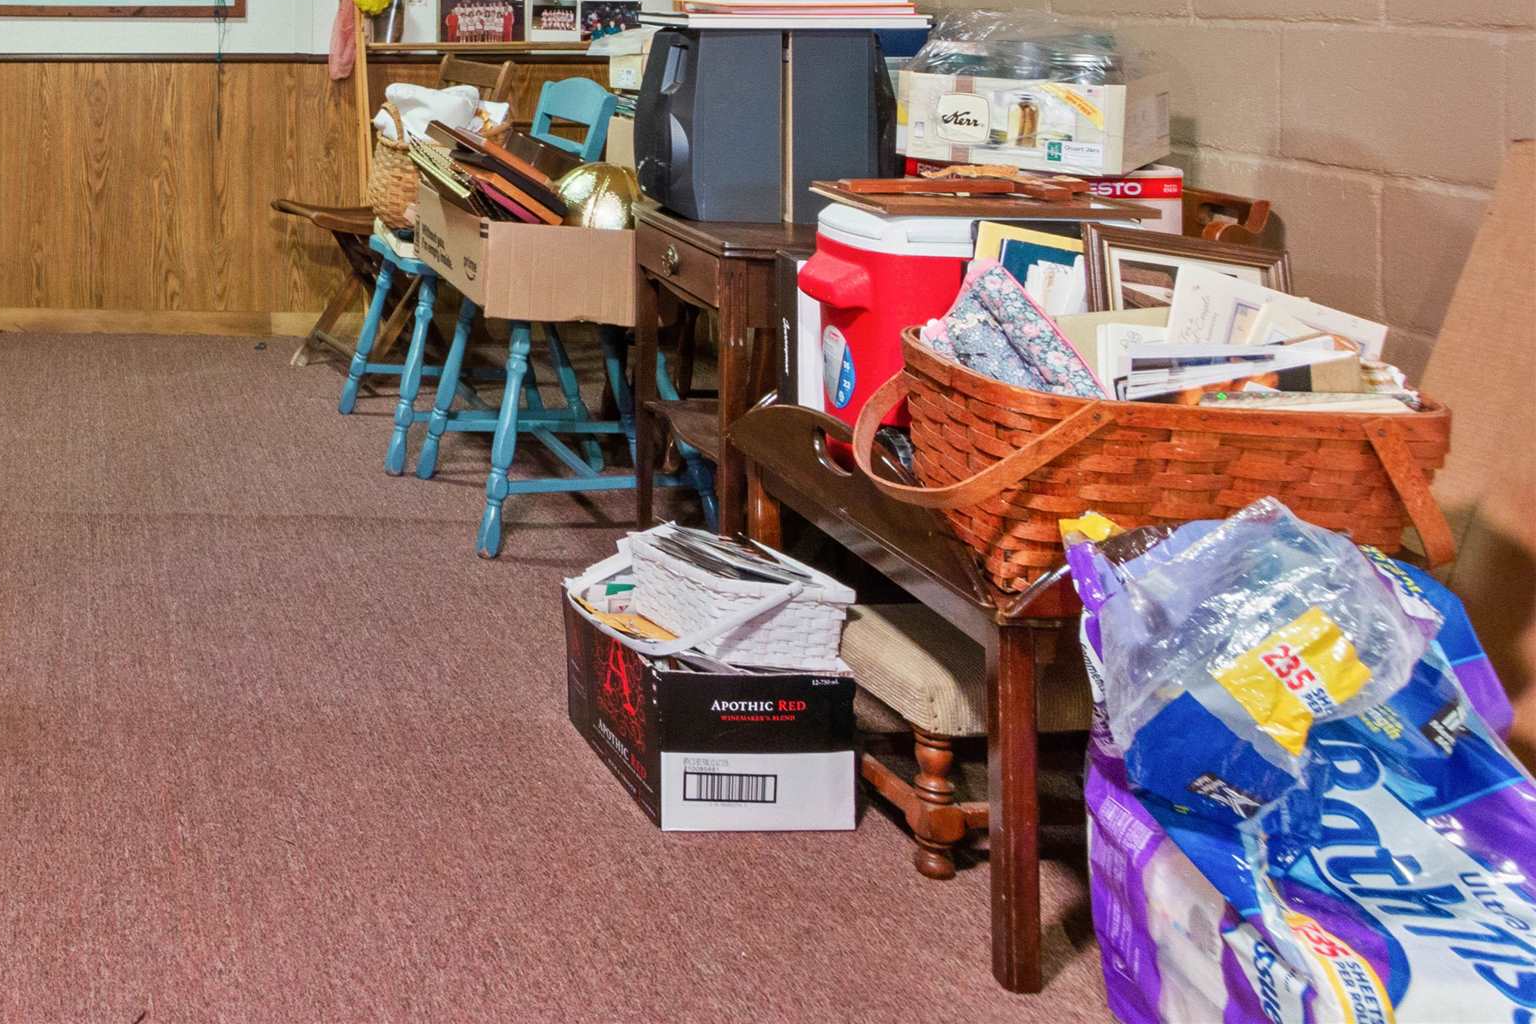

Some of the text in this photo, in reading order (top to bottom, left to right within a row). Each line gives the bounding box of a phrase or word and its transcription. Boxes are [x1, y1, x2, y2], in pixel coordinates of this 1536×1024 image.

[941, 111, 979, 127] Kerr
[1089, 181, 1142, 195] ESTO
[1262, 643, 1317, 691] 235
[710, 698, 807, 712] APOTHIC RED
